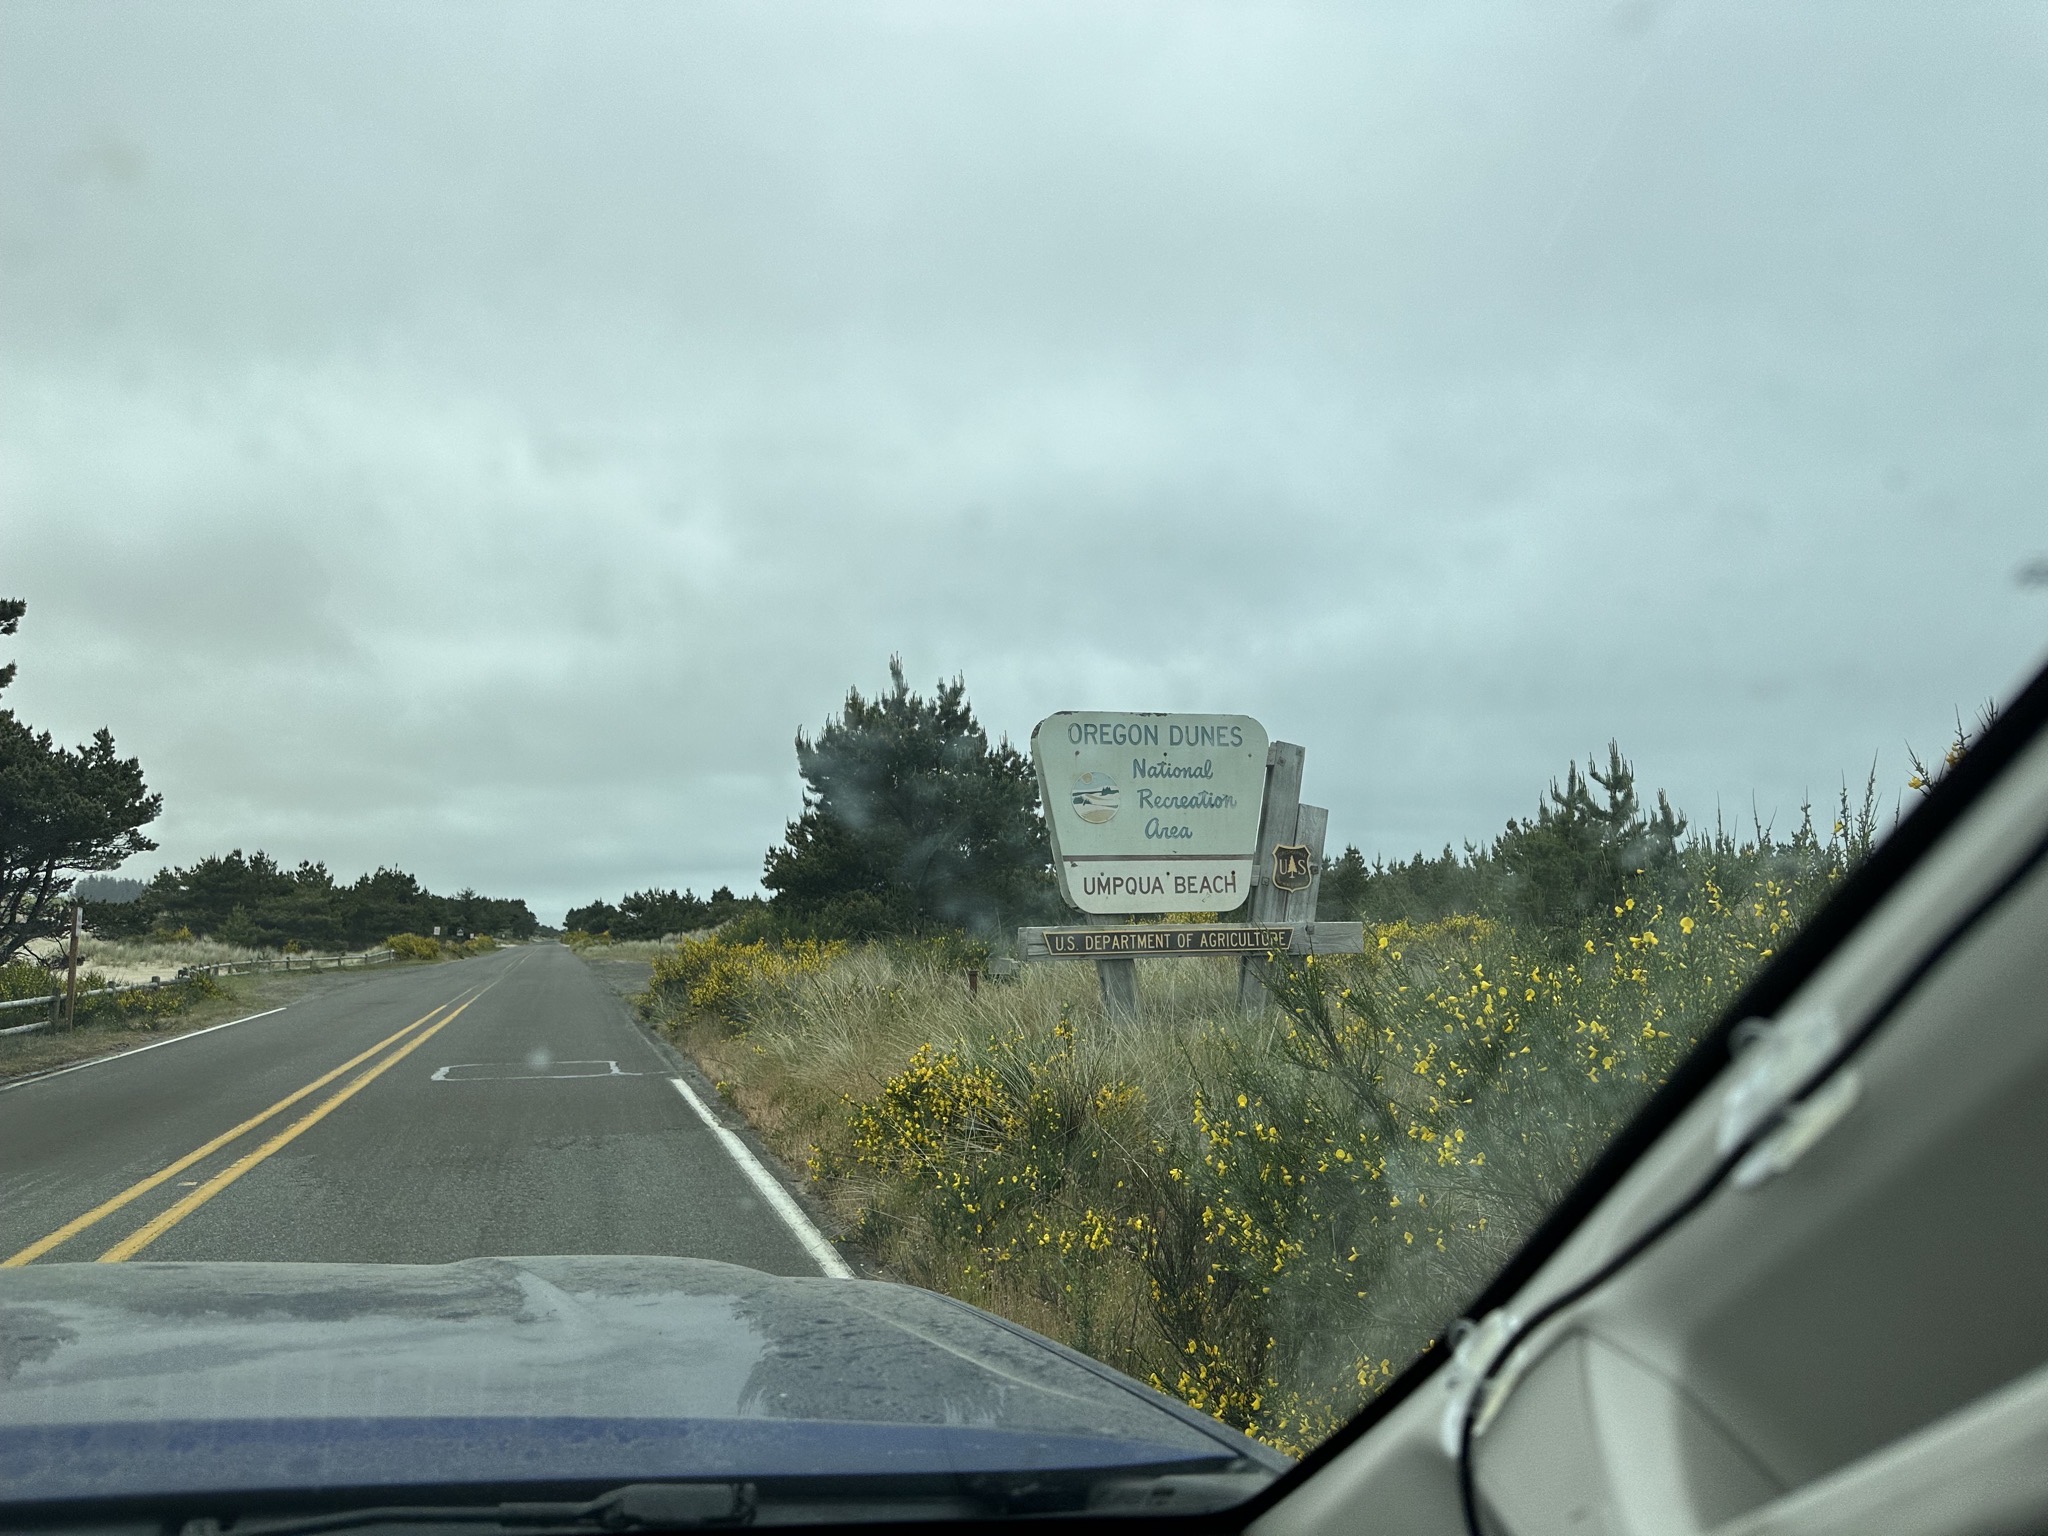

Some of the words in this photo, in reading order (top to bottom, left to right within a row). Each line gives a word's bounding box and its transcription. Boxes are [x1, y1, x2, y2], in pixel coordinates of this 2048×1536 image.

[1067, 722, 1159, 746] OREGON
[1169, 725, 1243, 748] DUNES
[1132, 758, 1214, 780] National
[1137, 788, 1238, 810] Recreation
[1144, 817, 1193, 840] Area
[1083, 876, 1165, 896] UMPQUA
[1173, 874, 1237, 894] BEACH
[1055, 936, 1079, 951] U.S.
[1085, 933, 1171, 951] DEPARTMENT
[1177, 933, 1194, 948] OF
